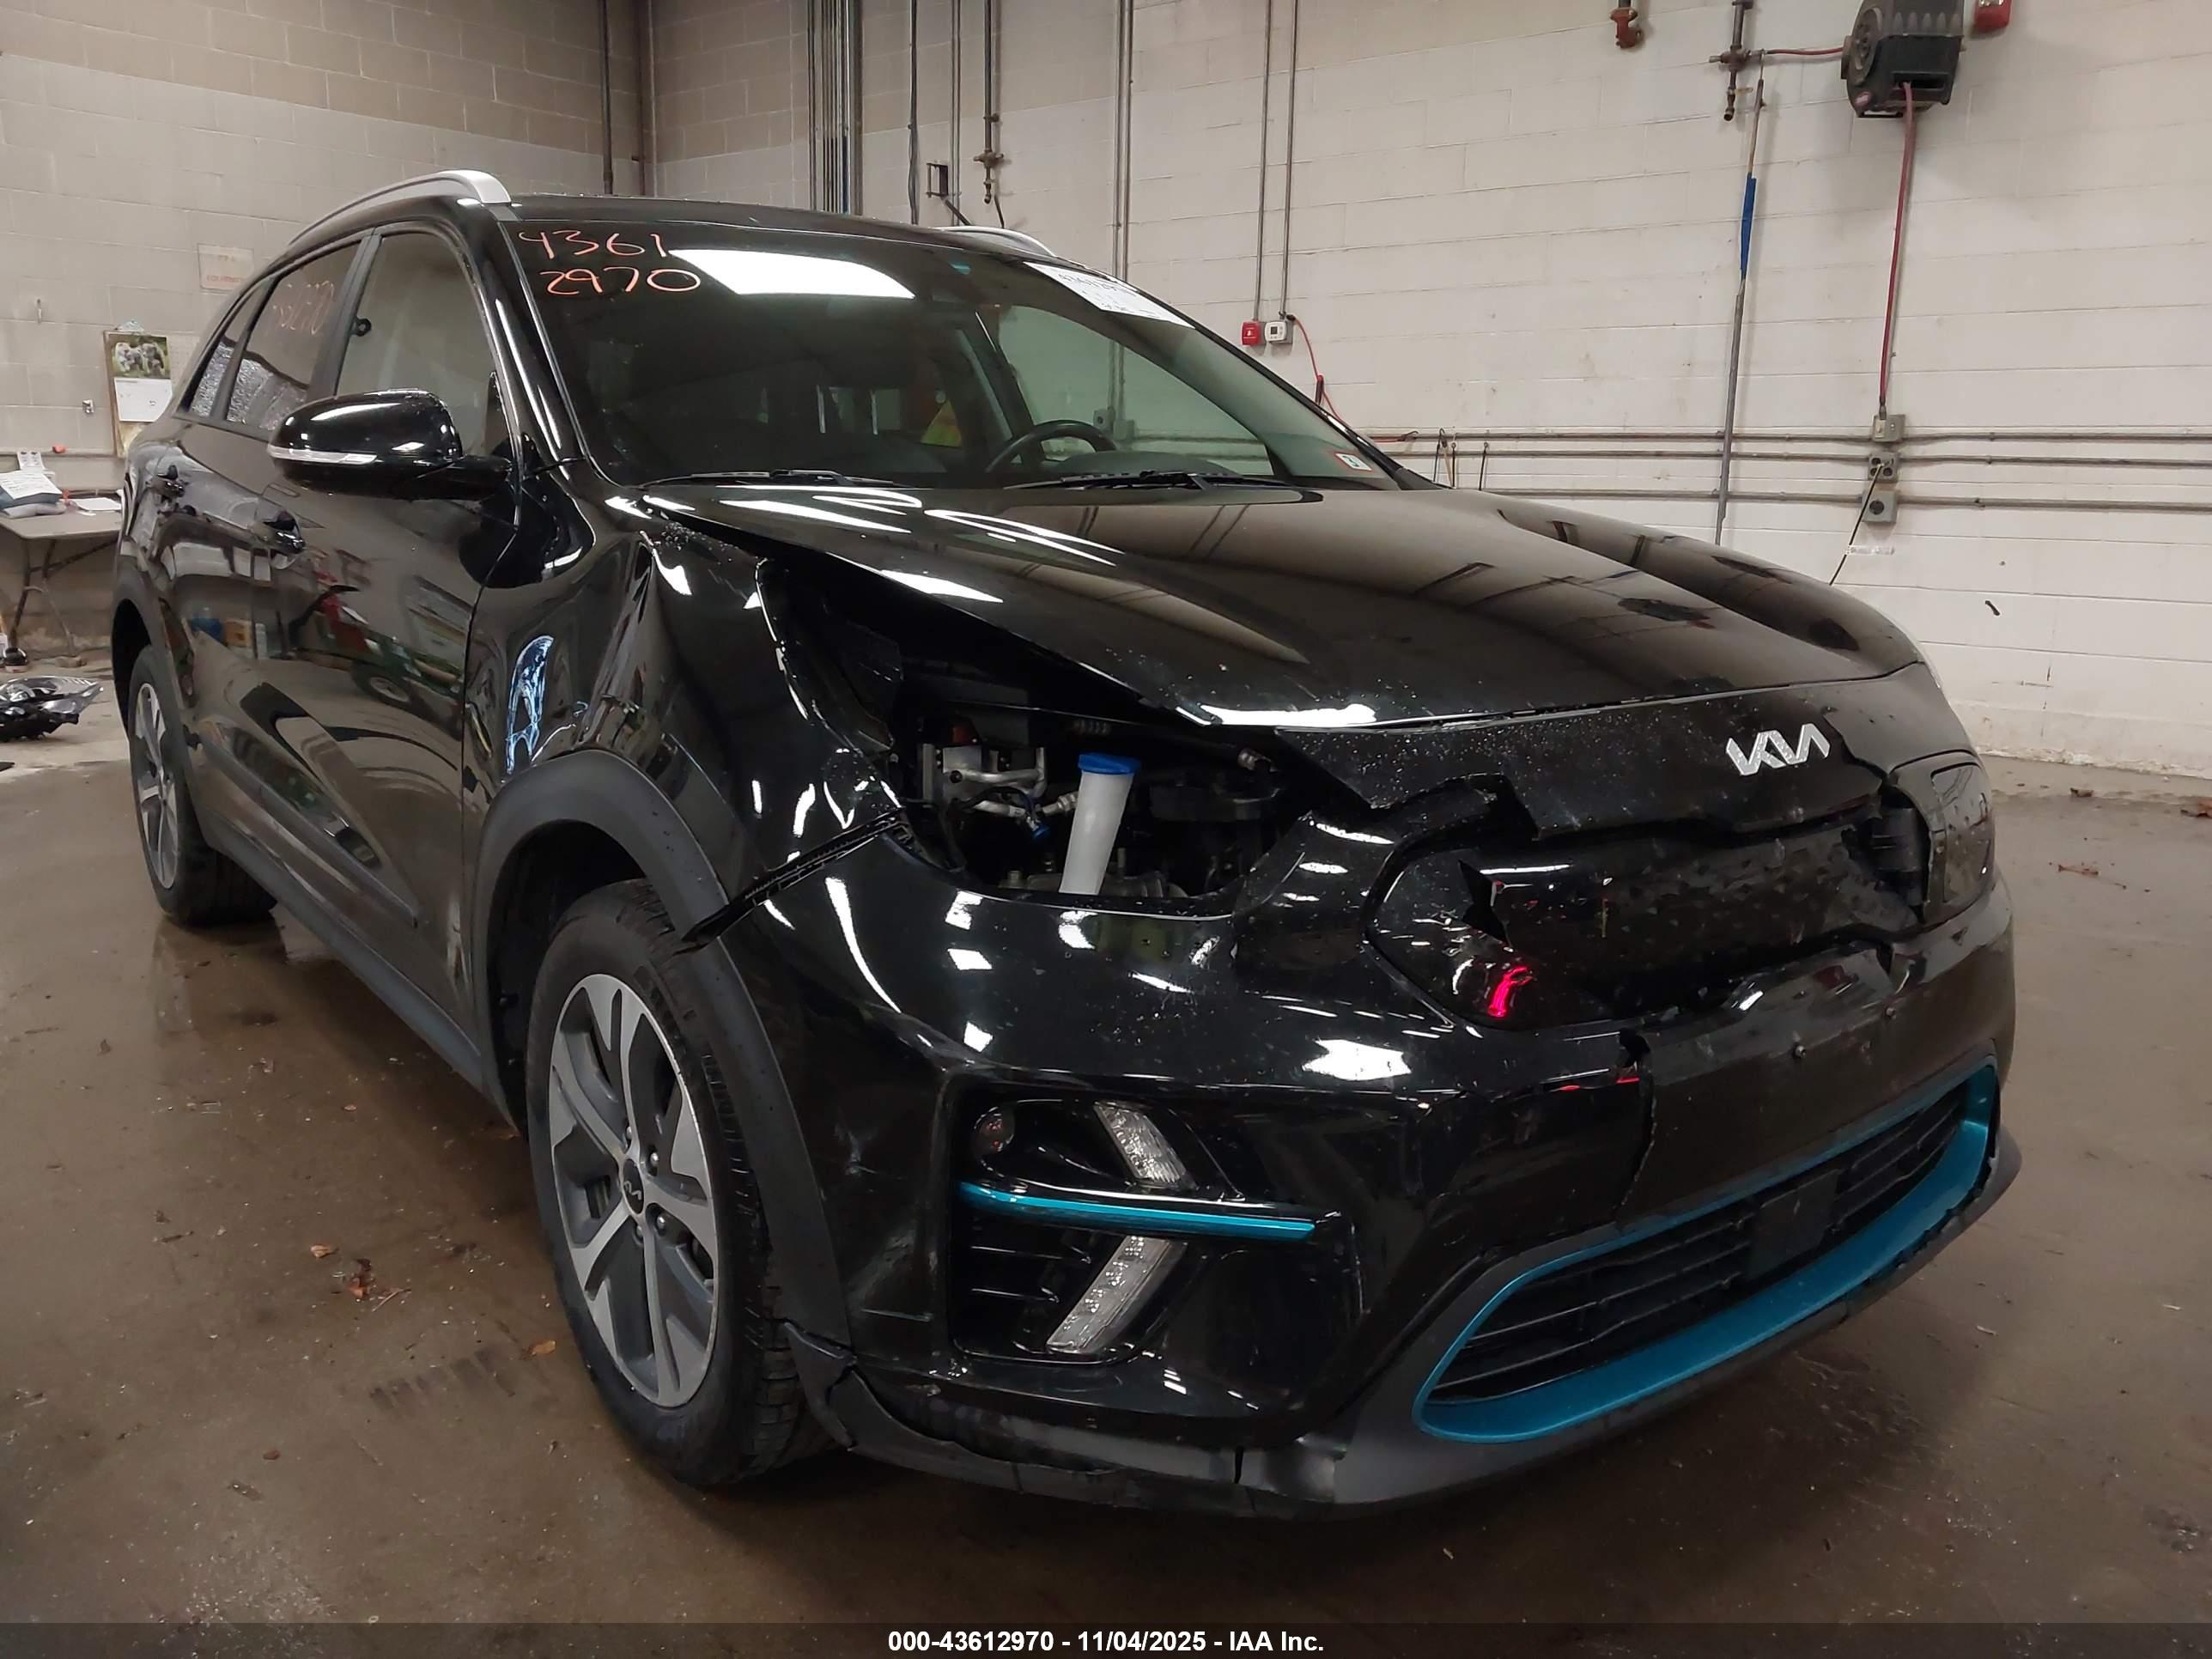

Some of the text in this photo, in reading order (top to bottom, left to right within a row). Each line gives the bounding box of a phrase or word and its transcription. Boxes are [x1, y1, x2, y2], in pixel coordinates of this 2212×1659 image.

[518, 229, 667, 258] 4361
[539, 266, 702, 295] 2970
[1726, 723, 1831, 776] KIA
